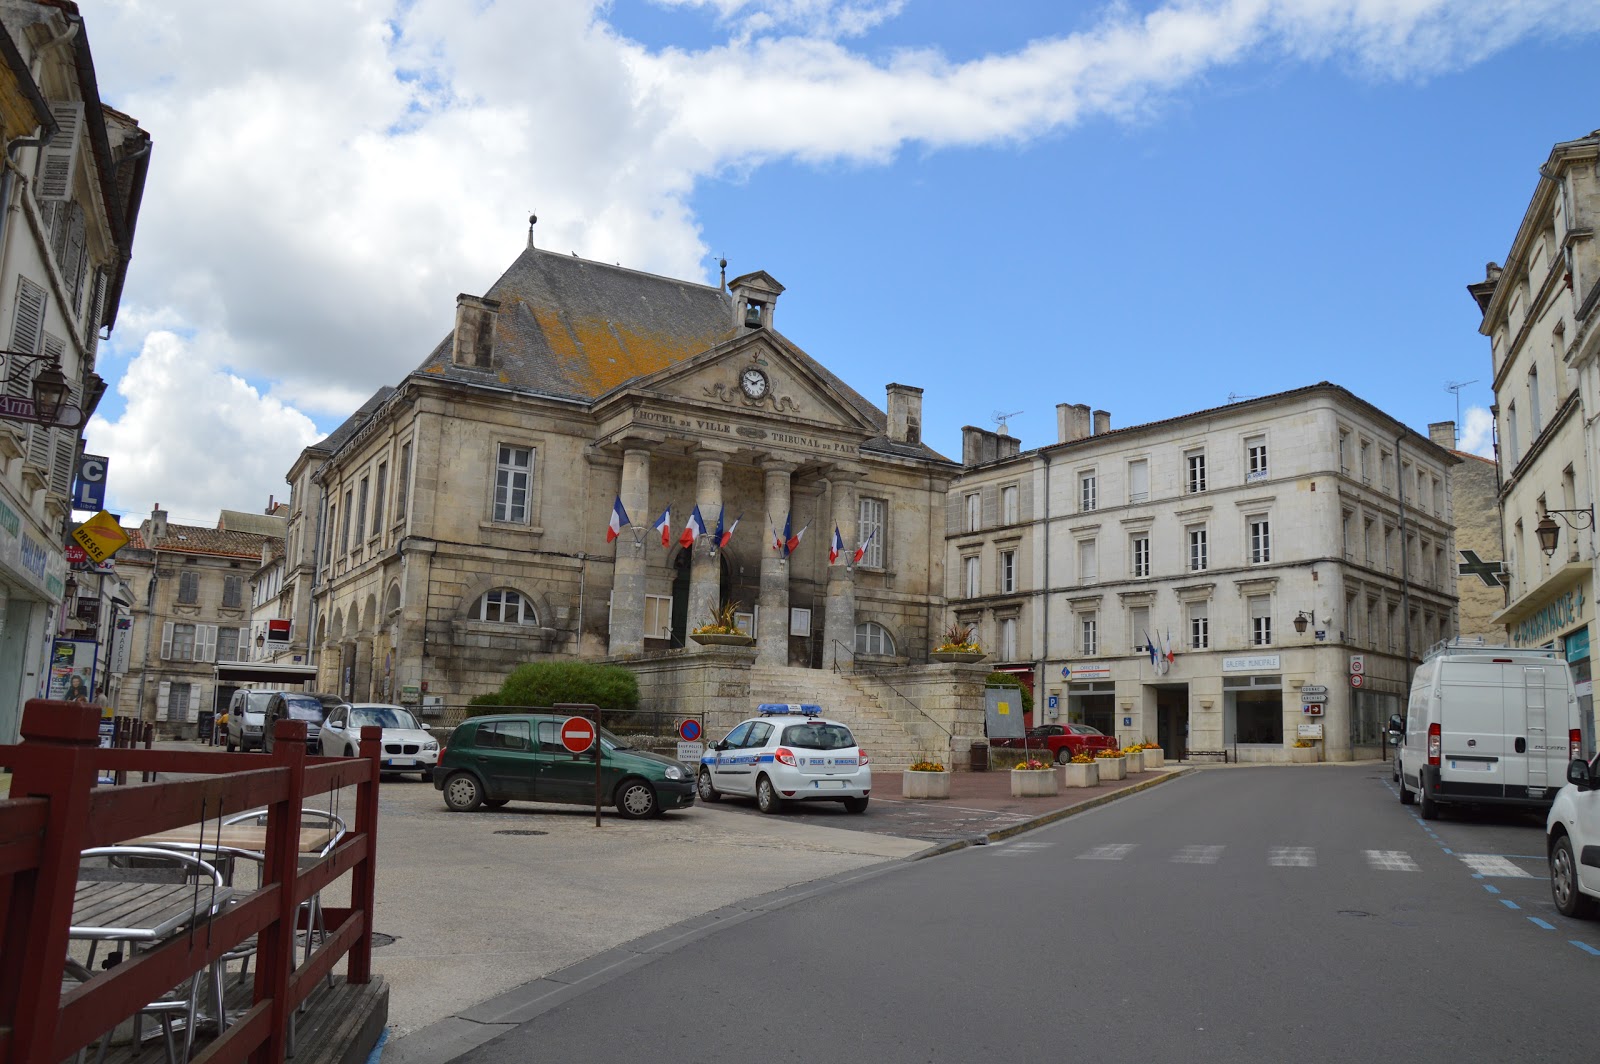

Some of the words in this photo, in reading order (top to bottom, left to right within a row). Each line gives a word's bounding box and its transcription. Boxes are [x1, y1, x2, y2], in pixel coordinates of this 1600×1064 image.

[640, 410, 676, 425] HOTEL
[697, 419, 731, 434] VILLE
[771, 431, 820, 449] TRIBUNAL
[834, 442, 856, 454] PAIX
[82, 461, 103, 481] C
[81, 484, 97, 504] L
[76, 529, 104, 559] PRESSE
[1520, 591, 1574, 647] PHARMACIE
